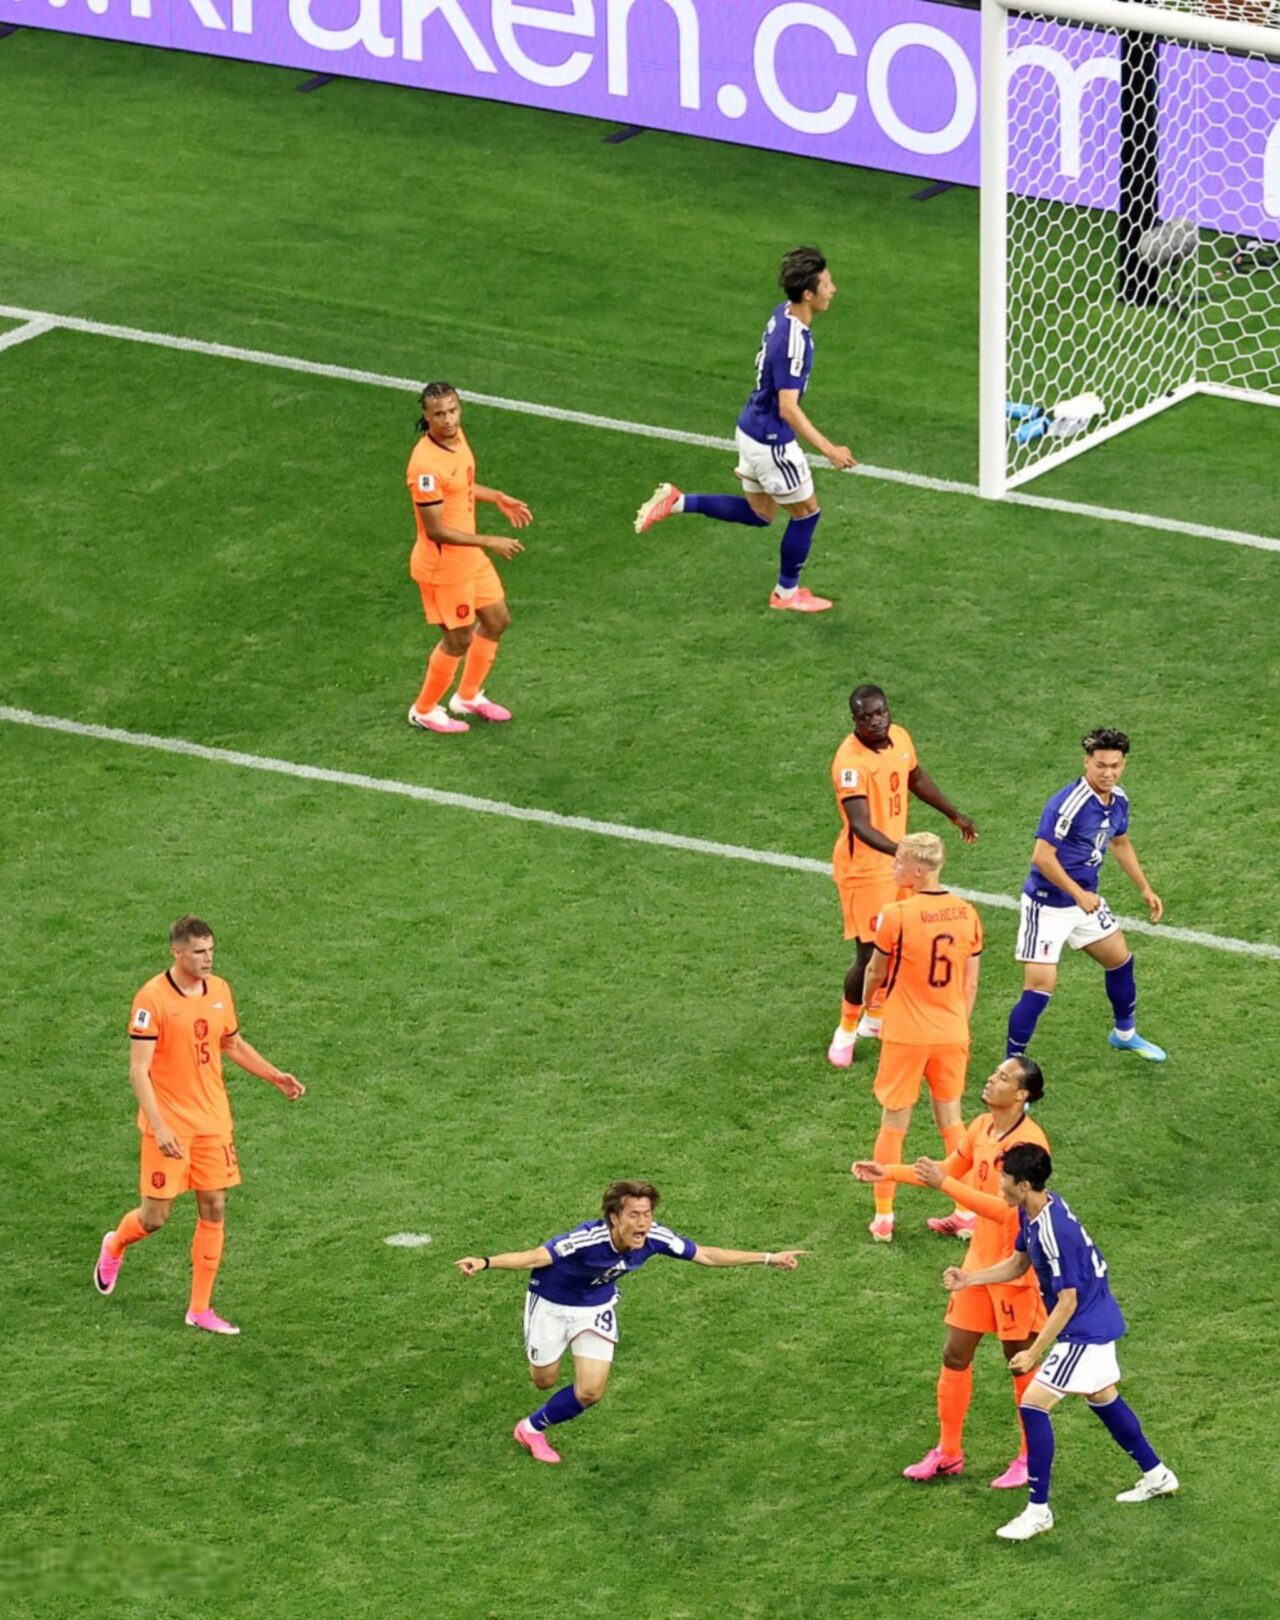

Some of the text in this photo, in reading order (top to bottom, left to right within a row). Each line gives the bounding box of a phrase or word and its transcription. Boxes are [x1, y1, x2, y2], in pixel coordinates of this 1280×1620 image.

[928, 934, 955, 987] 6
[194, 1042, 210, 1066] 15
[1001, 1299, 1015, 1322] 4
